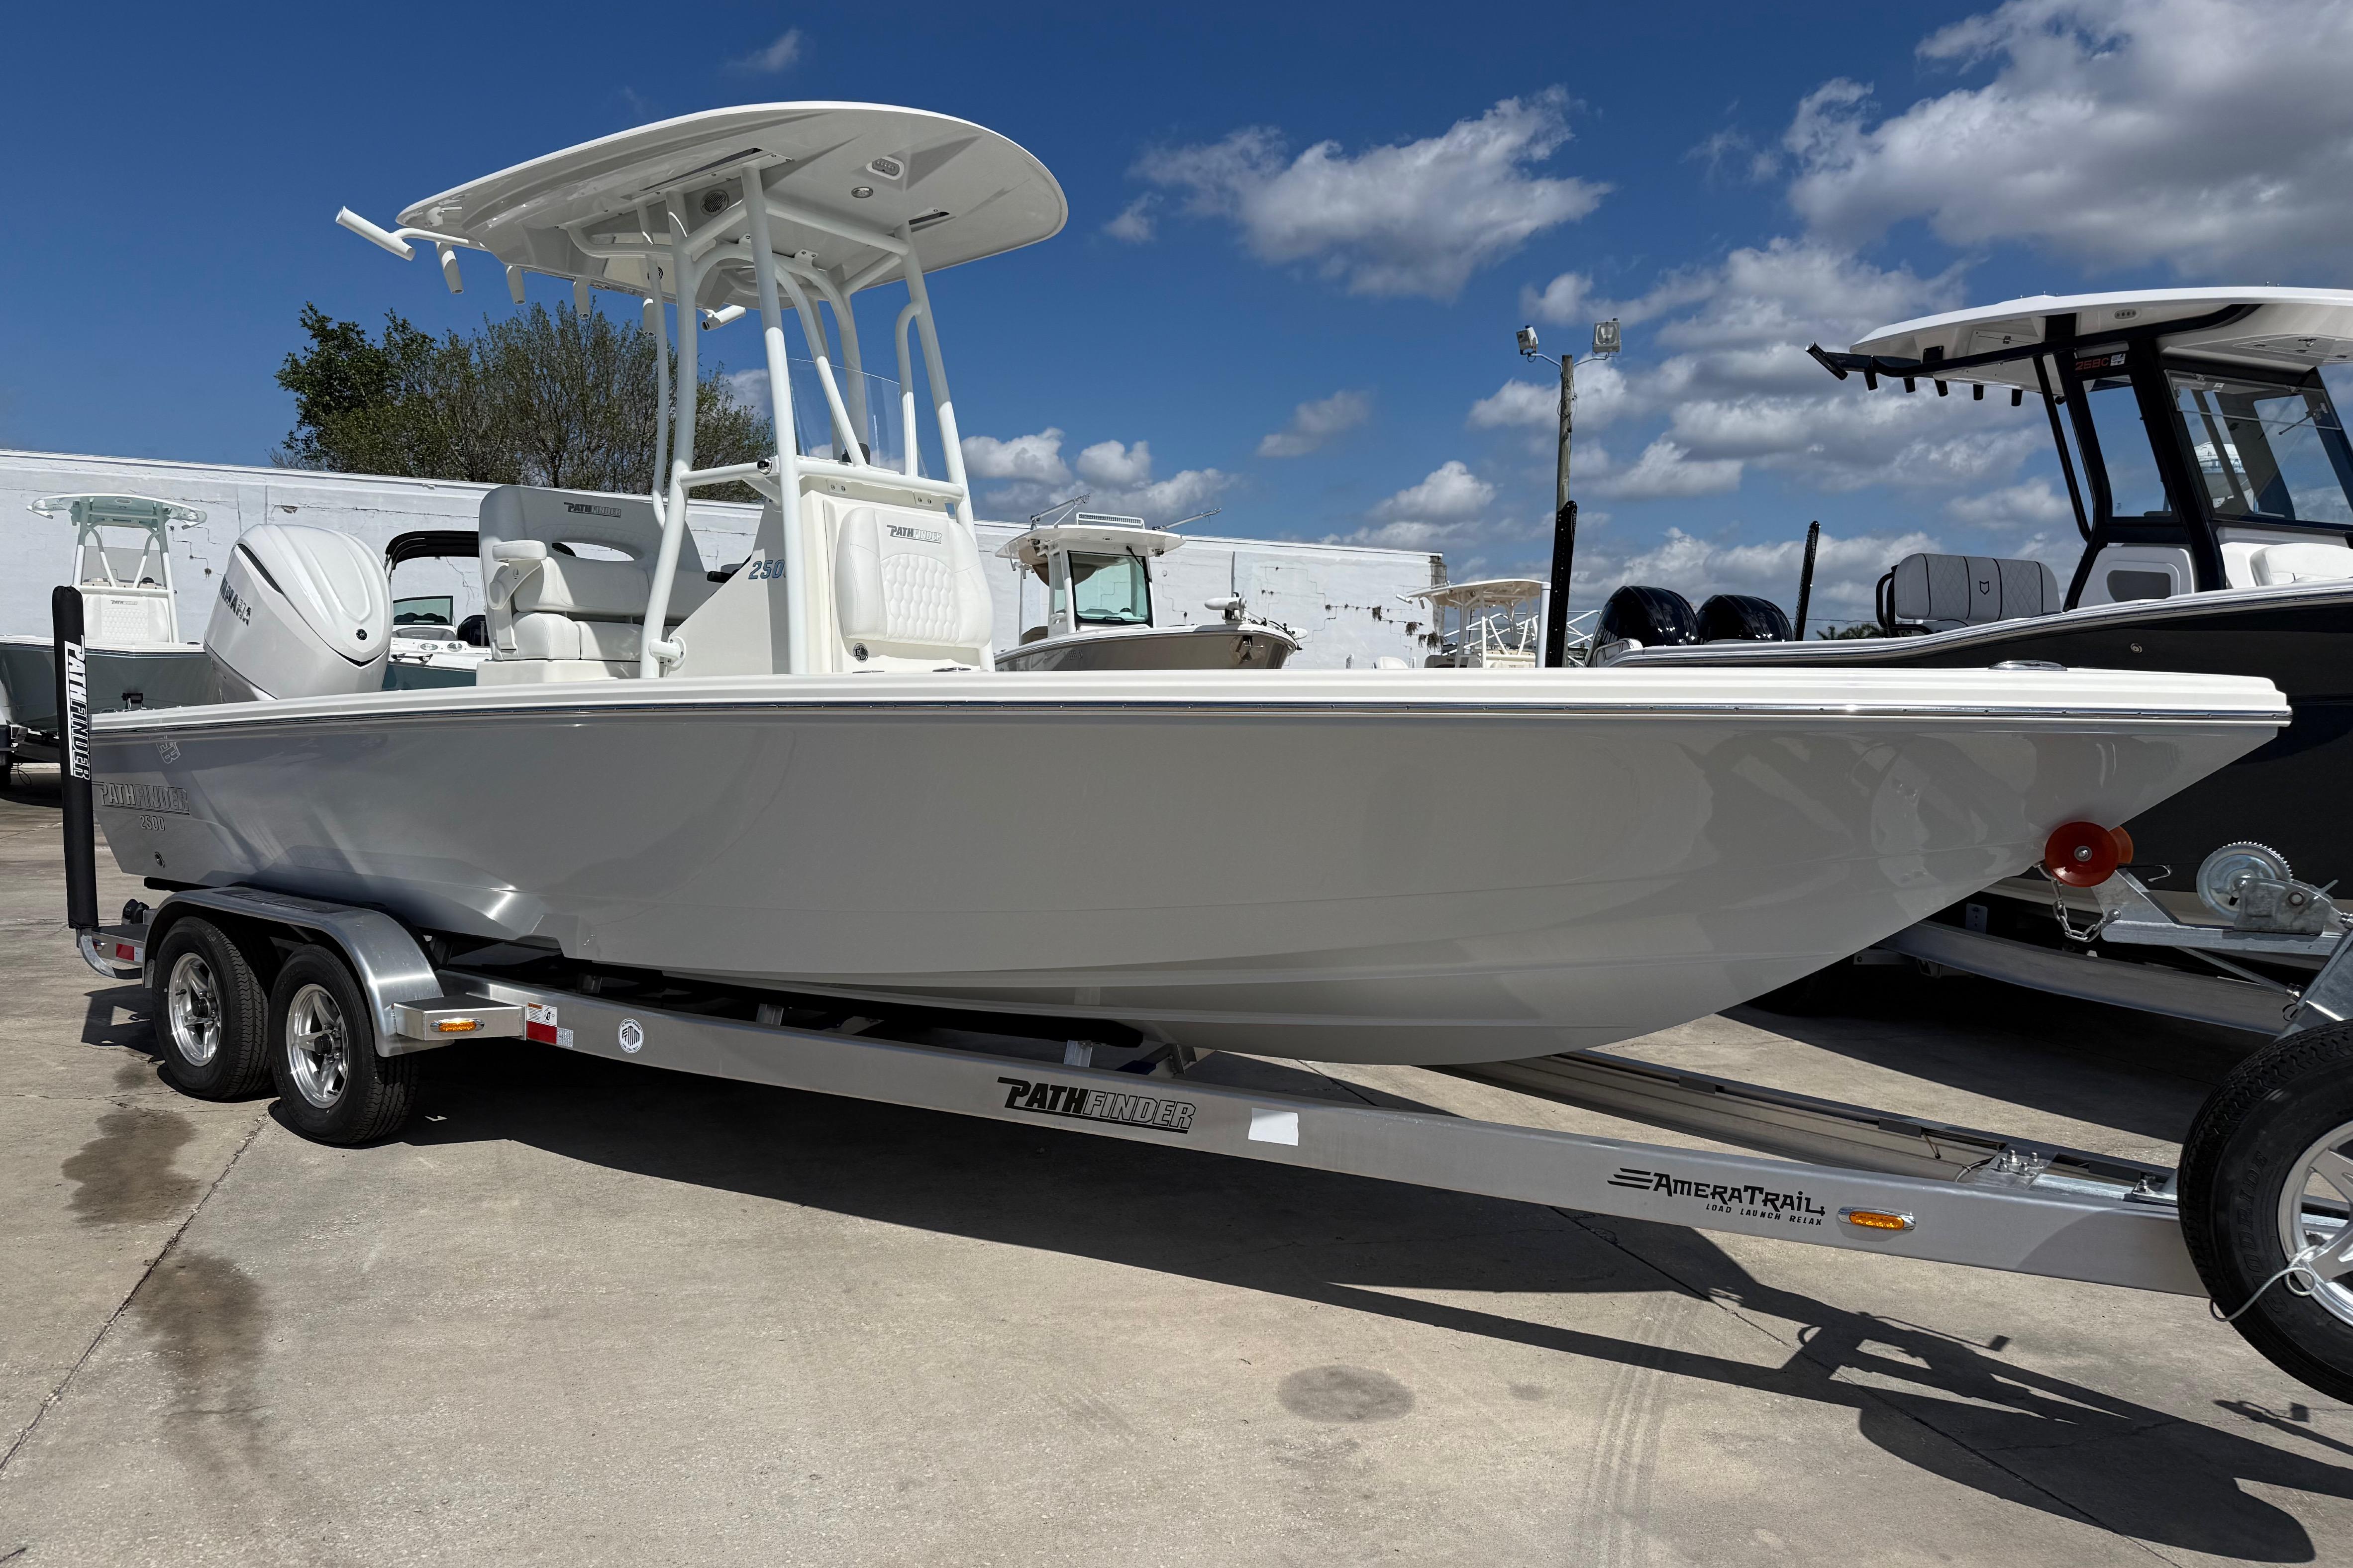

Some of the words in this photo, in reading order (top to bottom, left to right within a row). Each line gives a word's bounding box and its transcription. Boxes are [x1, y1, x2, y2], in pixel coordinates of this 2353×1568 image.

[564, 502, 621, 518] PATHFINDER
[887, 524, 942, 544] PATHFINDER
[748, 559, 786, 580] 250
[64, 635, 91, 781] PATHFINDER
[92, 782, 190, 815] PATHFINDER
[140, 814, 166, 831] 2500
[997, 1077, 1196, 1134] PATHFINDER
[1706, 1203, 1732, 1213] LOAD
[1740, 1208, 1781, 1220] LAUNCH
[1789, 1215, 1822, 1226] RELAX
